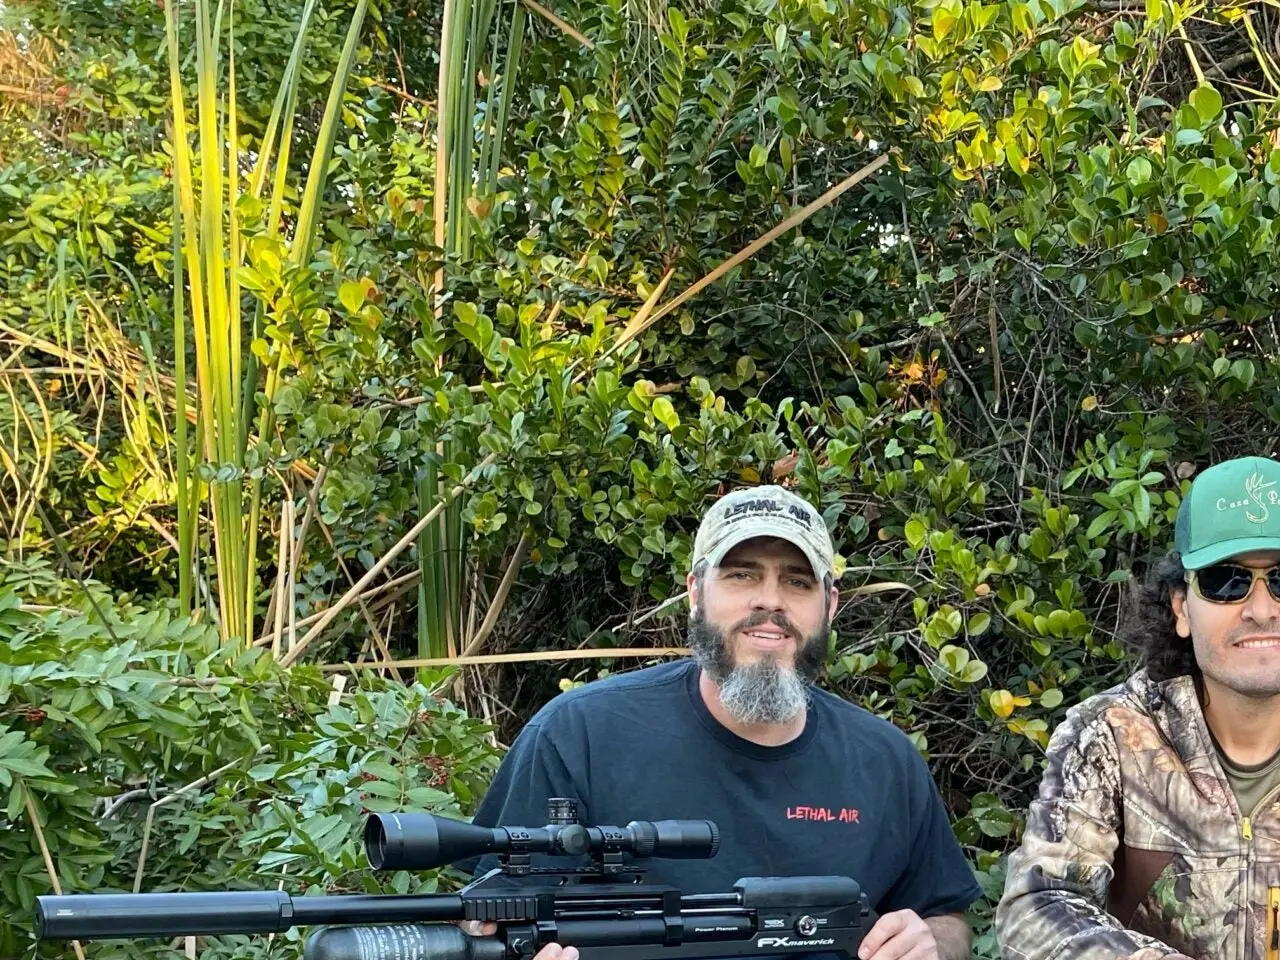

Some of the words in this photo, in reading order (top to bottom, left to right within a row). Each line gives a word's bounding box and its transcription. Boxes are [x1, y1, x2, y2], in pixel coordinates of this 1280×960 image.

[724, 499, 783, 519] LETHAL
[788, 505, 812, 527] AIR
[786, 806, 836, 821] LETHAL
[839, 807, 860, 825] AIR
[757, 937, 789, 948] FX
